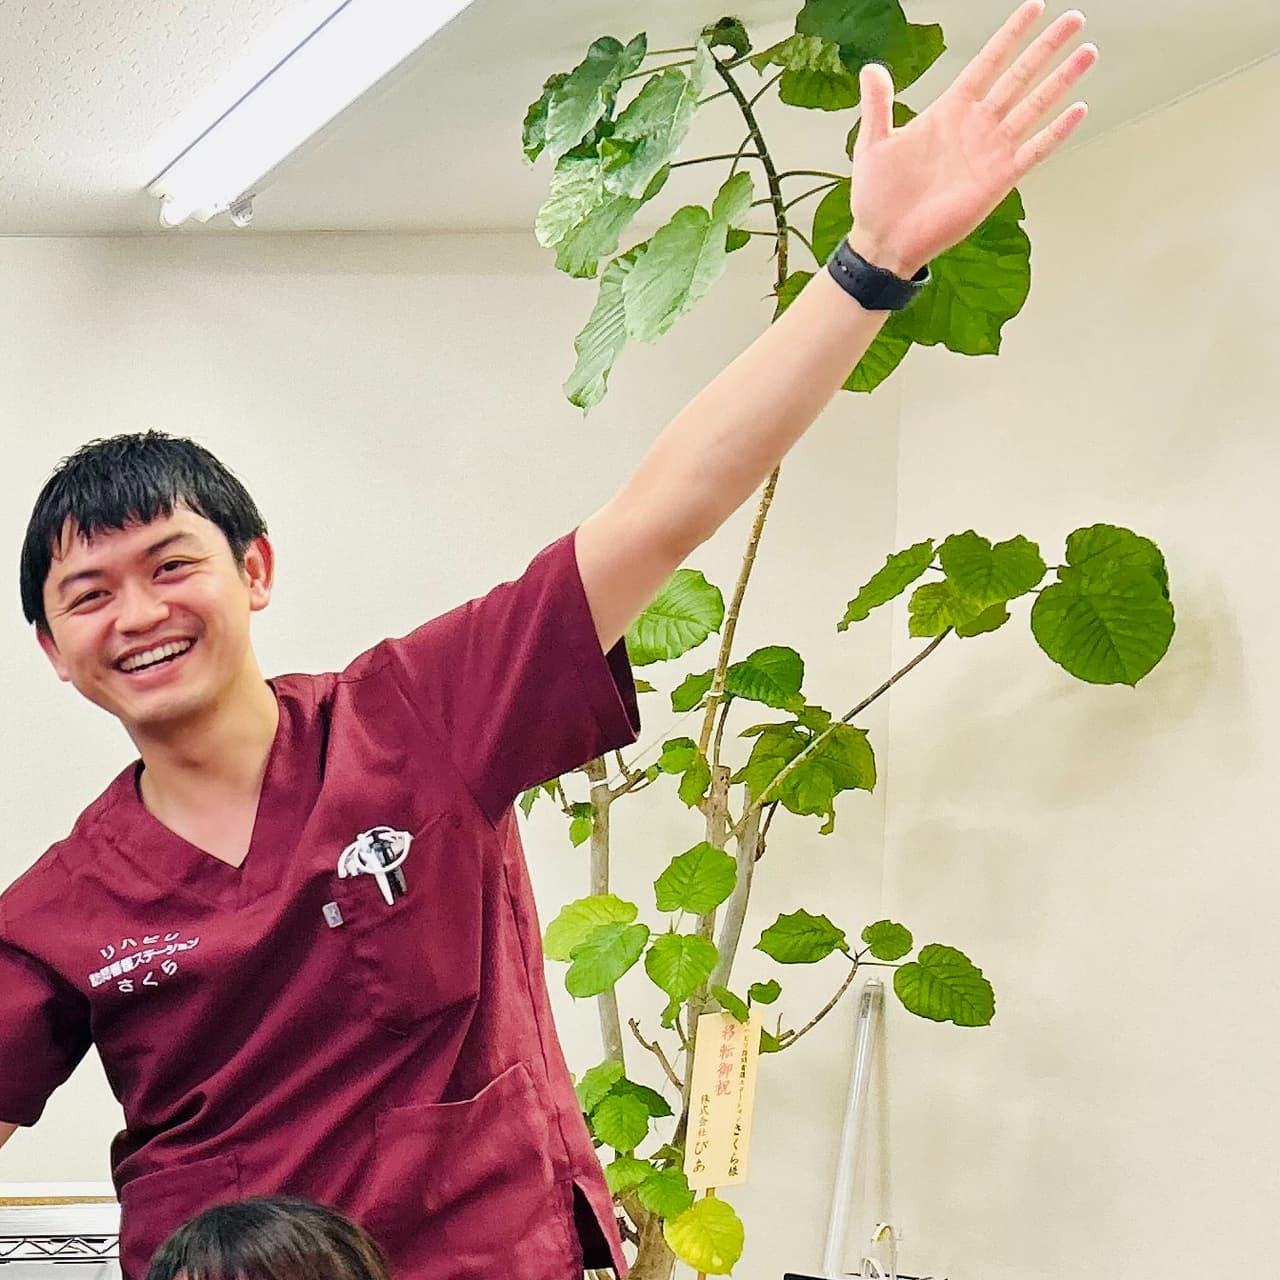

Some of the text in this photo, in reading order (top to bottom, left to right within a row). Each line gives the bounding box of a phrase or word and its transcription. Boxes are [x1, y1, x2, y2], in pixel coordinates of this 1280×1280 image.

[100, 932, 179, 959] リハビリ
[118, 959, 178, 993] さくら
